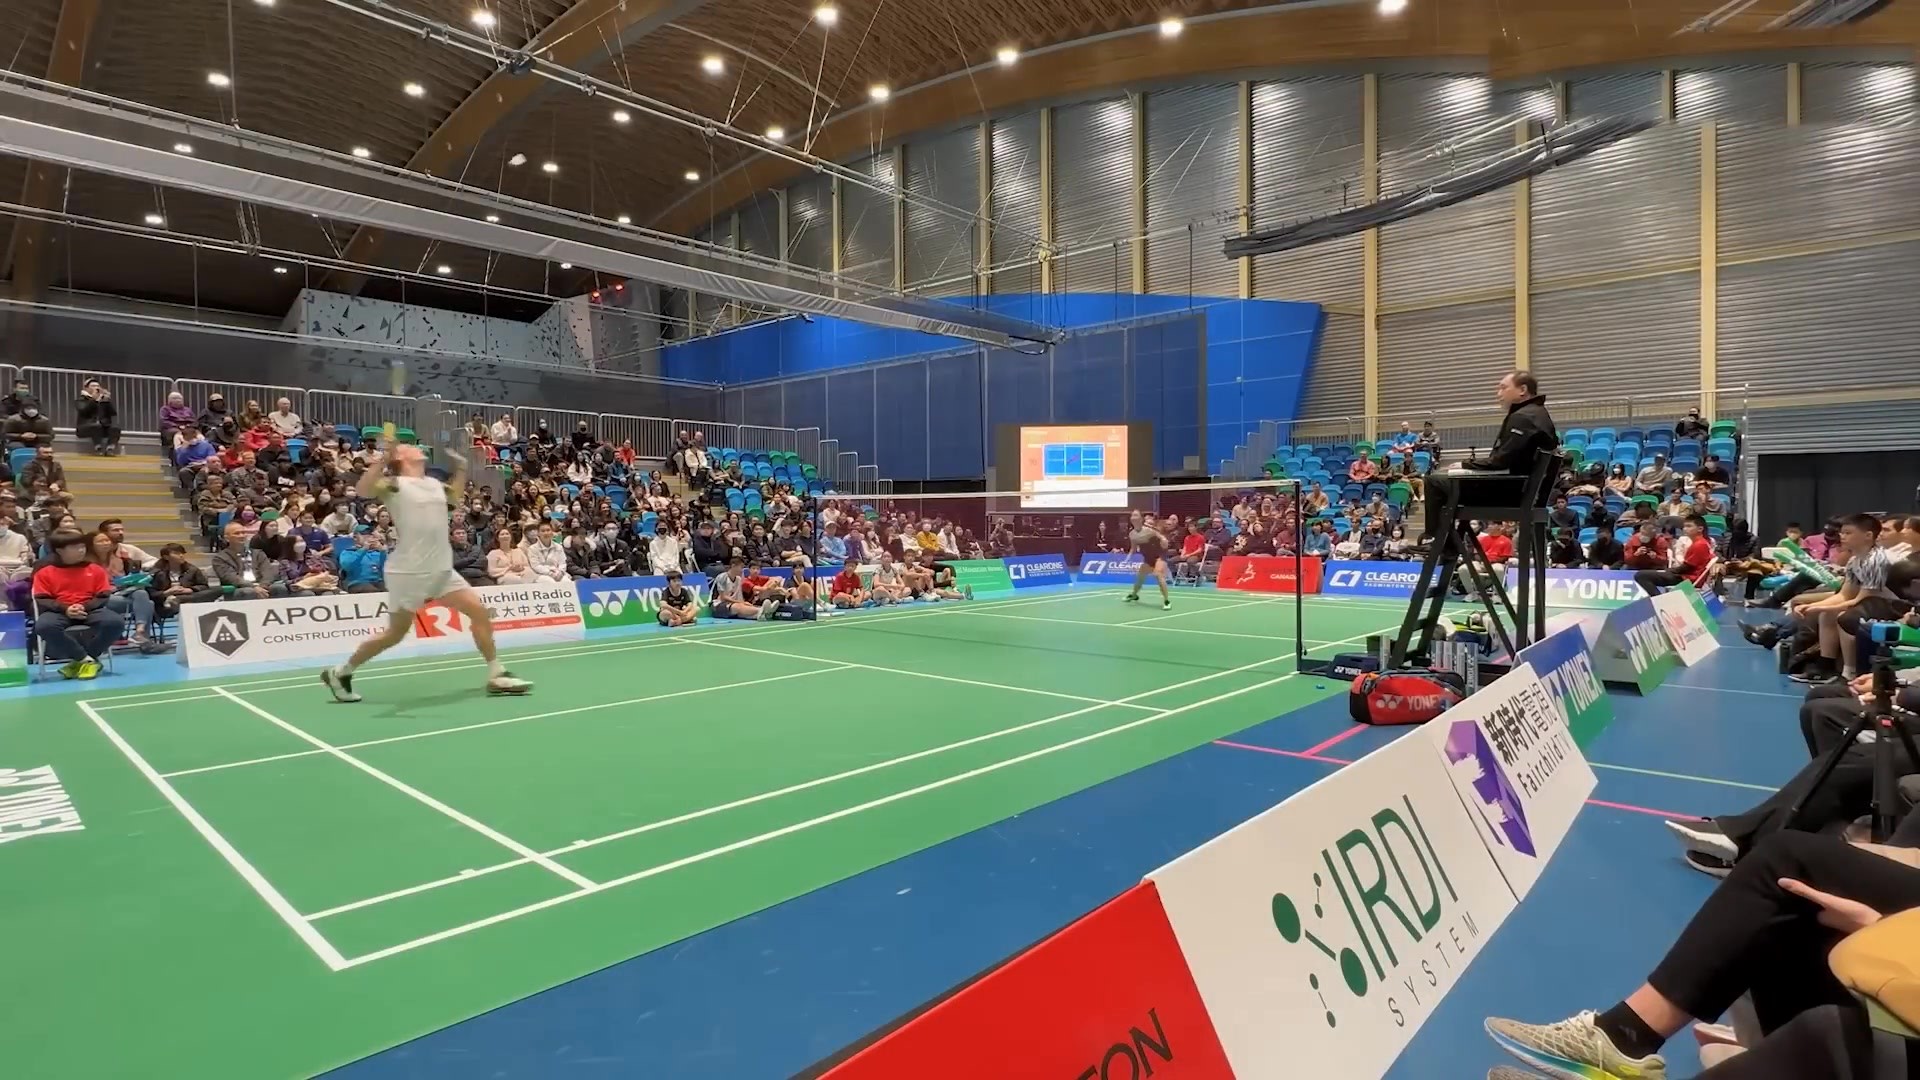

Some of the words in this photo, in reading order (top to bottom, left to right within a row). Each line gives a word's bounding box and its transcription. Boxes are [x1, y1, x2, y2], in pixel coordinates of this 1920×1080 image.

[533, 589, 572, 600] Radio
[263, 628, 370, 644] CONSTRUCTION
[1558, 650, 1603, 715] YONEX
[1321, 794, 1459, 982] IRDI
[1387, 911, 1480, 1027] SYSTEM
